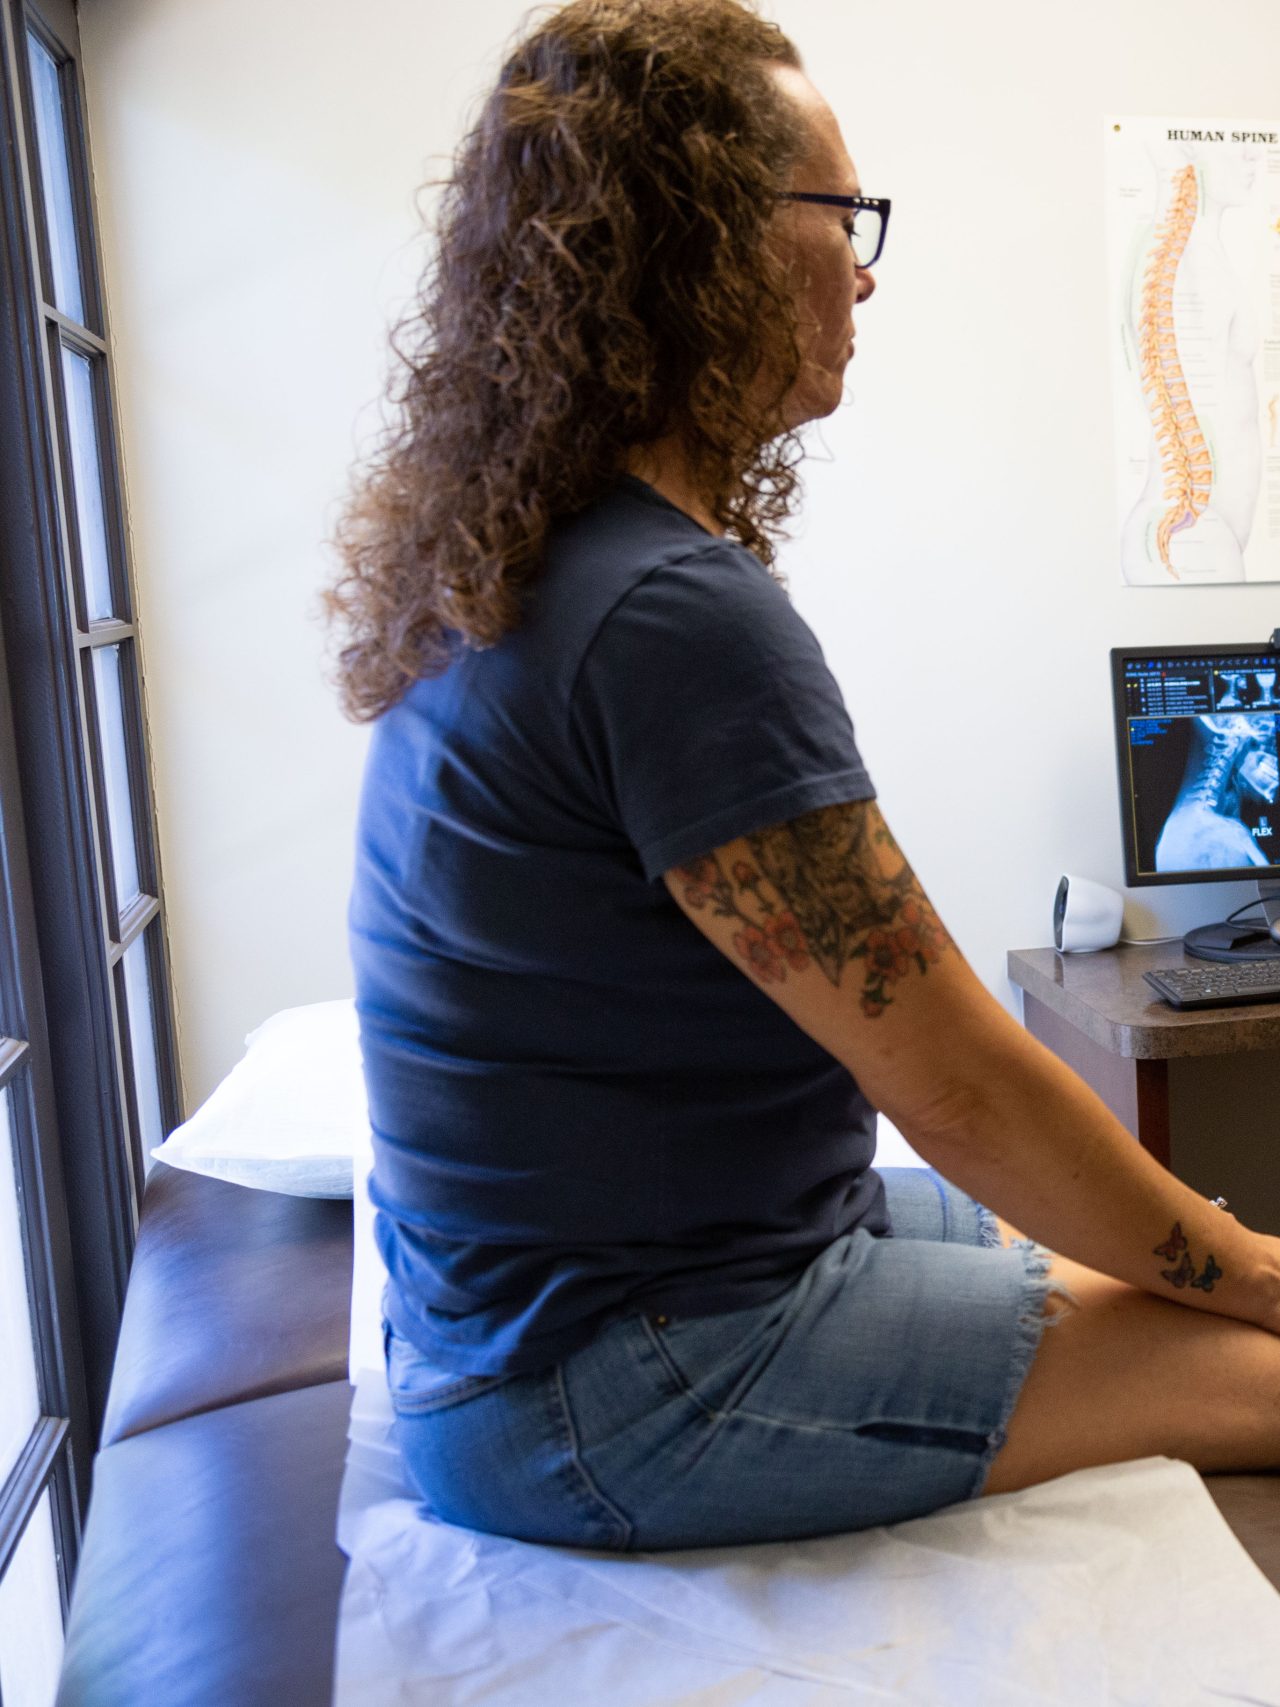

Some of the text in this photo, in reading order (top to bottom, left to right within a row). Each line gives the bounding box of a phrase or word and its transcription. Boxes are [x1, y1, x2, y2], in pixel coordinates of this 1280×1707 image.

[1167, 129, 1225, 142] HUMAN
[1231, 131, 1279, 145] SPINE
[1252, 827, 1273, 837] FLEX
